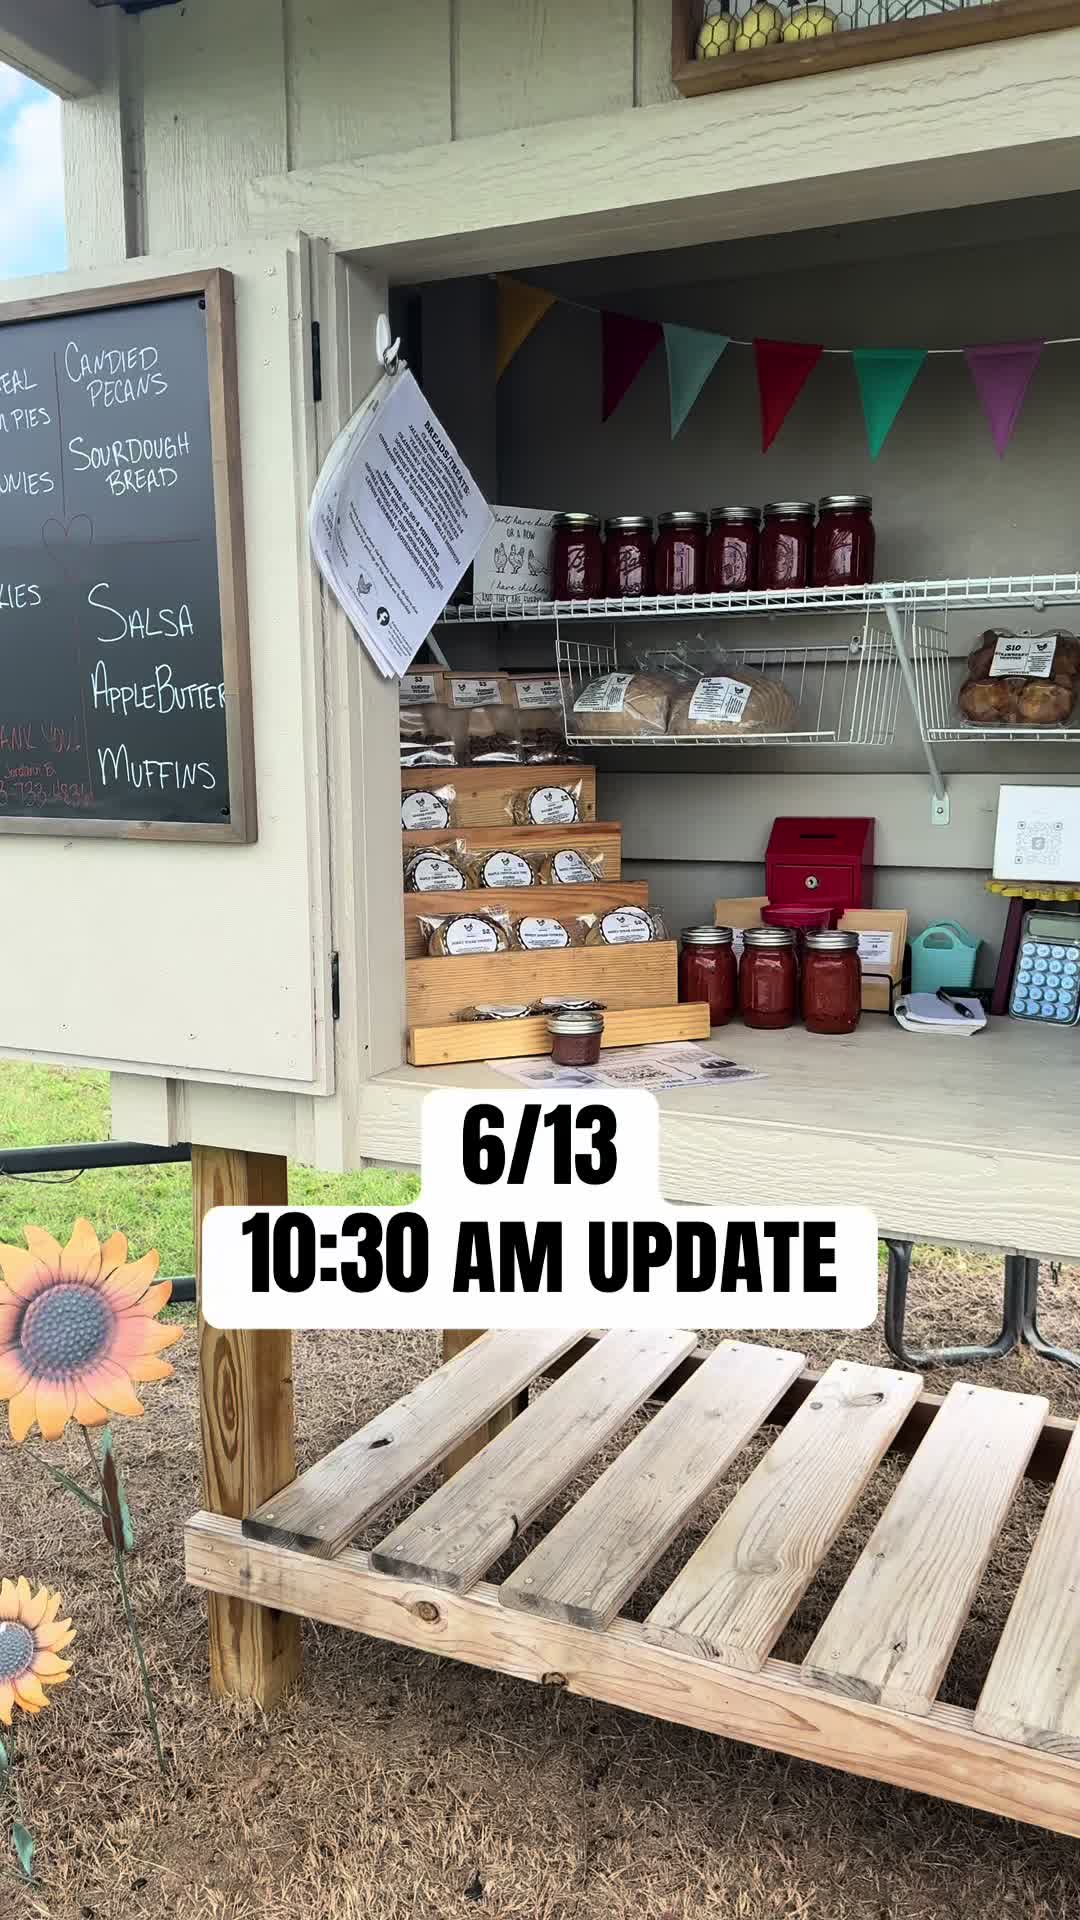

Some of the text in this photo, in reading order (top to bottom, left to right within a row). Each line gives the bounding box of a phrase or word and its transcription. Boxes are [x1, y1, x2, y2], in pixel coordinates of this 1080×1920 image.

[65, 341, 158, 382] CANDIED
[86, 373, 168, 407] PECANS
[10, 407, 51, 430] PIES
[68, 431, 190, 470] SOURDOUGH
[105, 467, 178, 496] BREAD
[534, 517, 553, 527] duck
[88, 583, 194, 642] SALSA
[98, 744, 216, 789] MUFFINS
